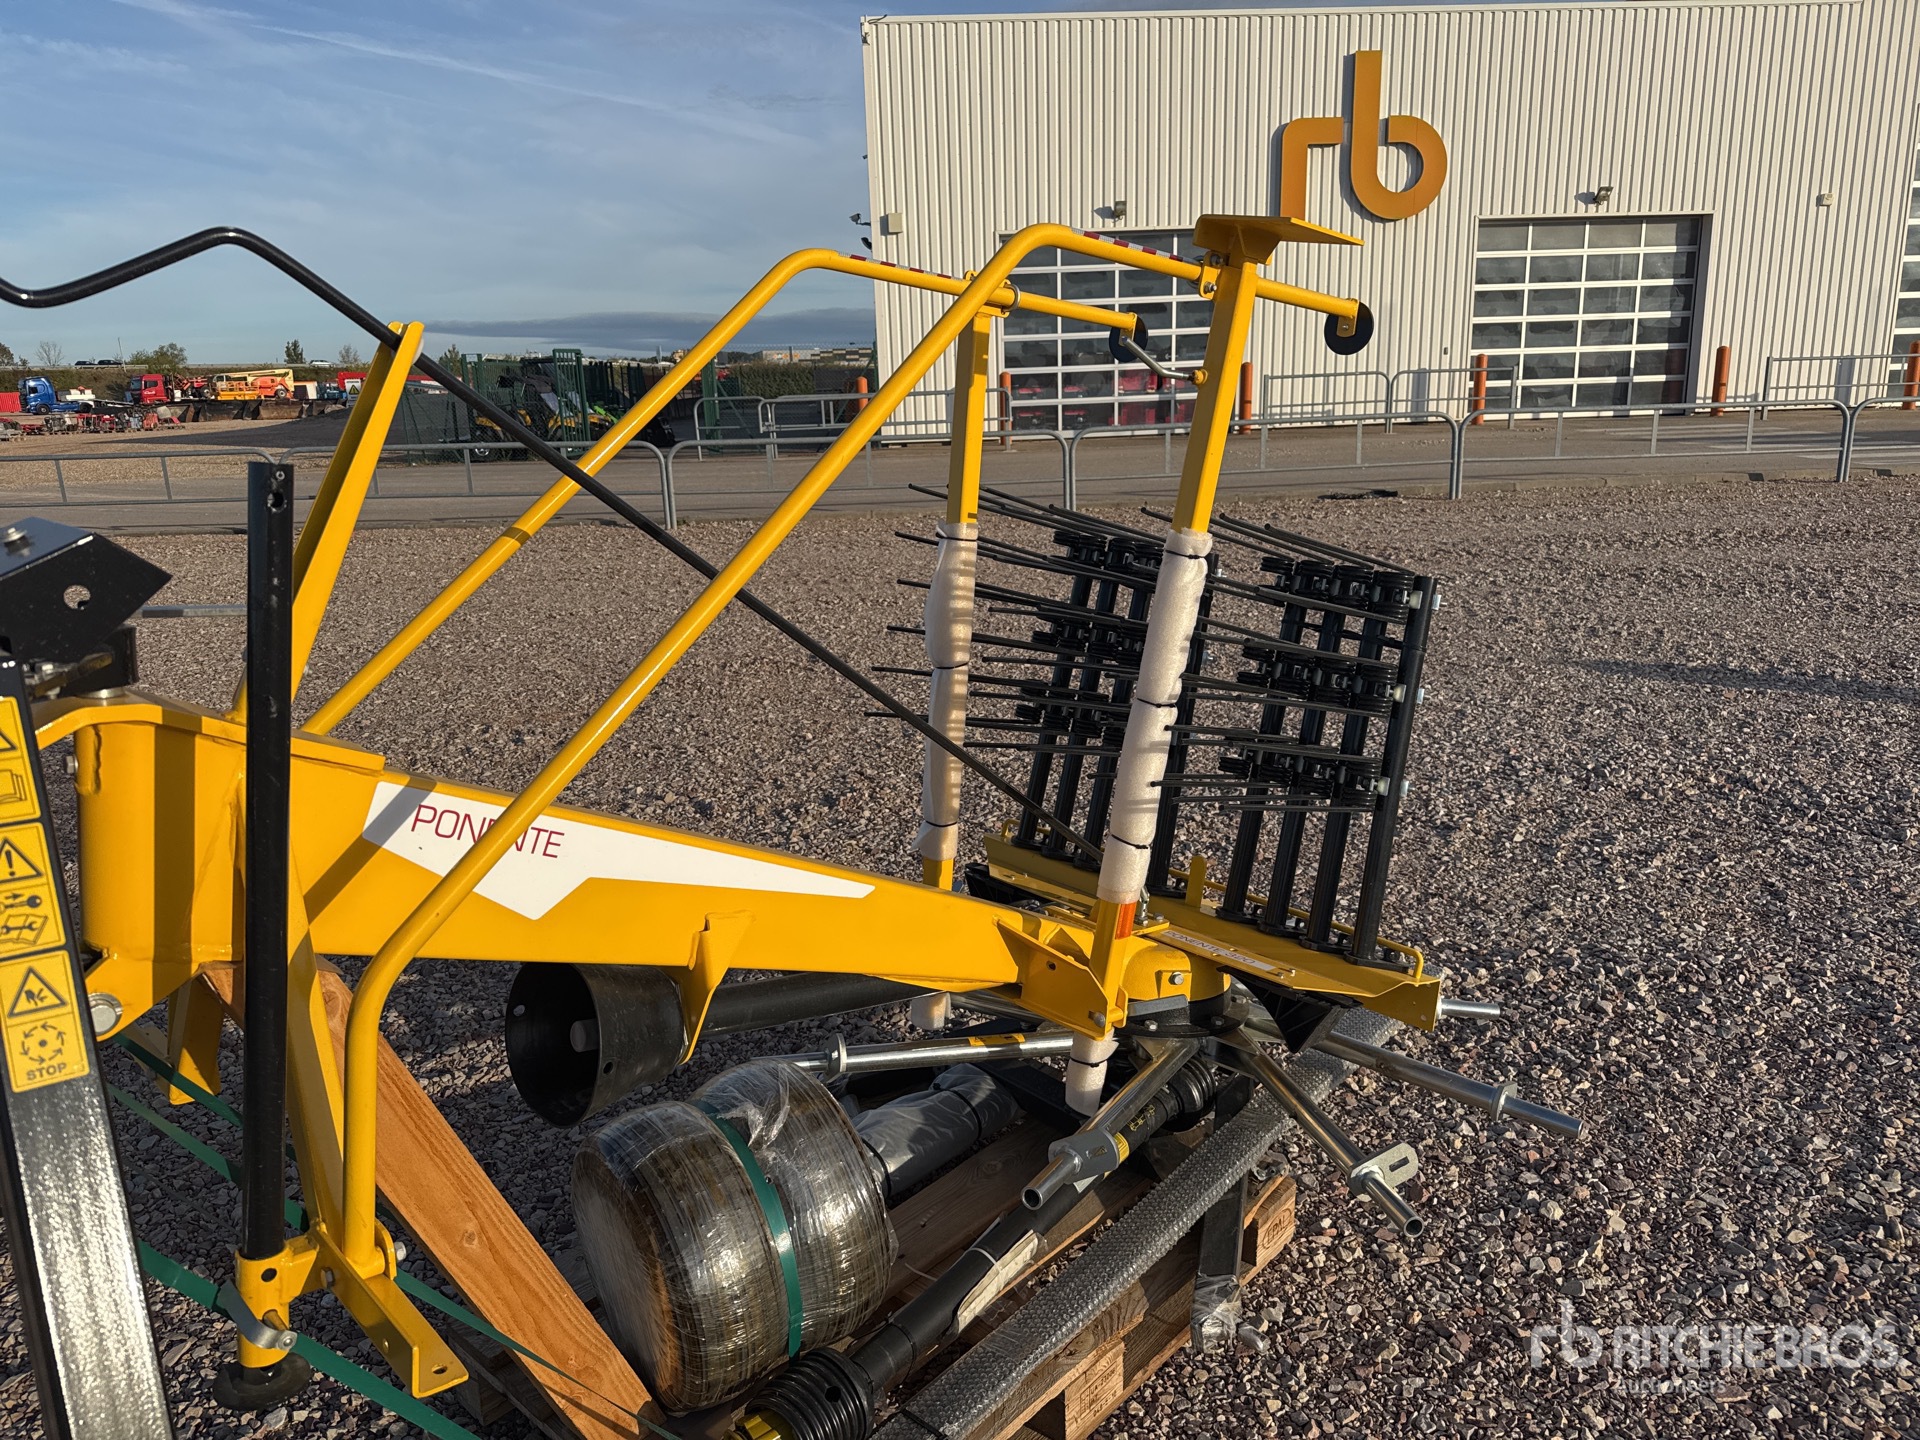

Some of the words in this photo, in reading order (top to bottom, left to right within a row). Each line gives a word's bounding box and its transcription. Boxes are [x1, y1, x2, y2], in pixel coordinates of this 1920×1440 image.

[1280, 50, 1448, 219] rb
[411, 804, 565, 858] PONNTE
[26, 1062, 67, 1080] STOP
